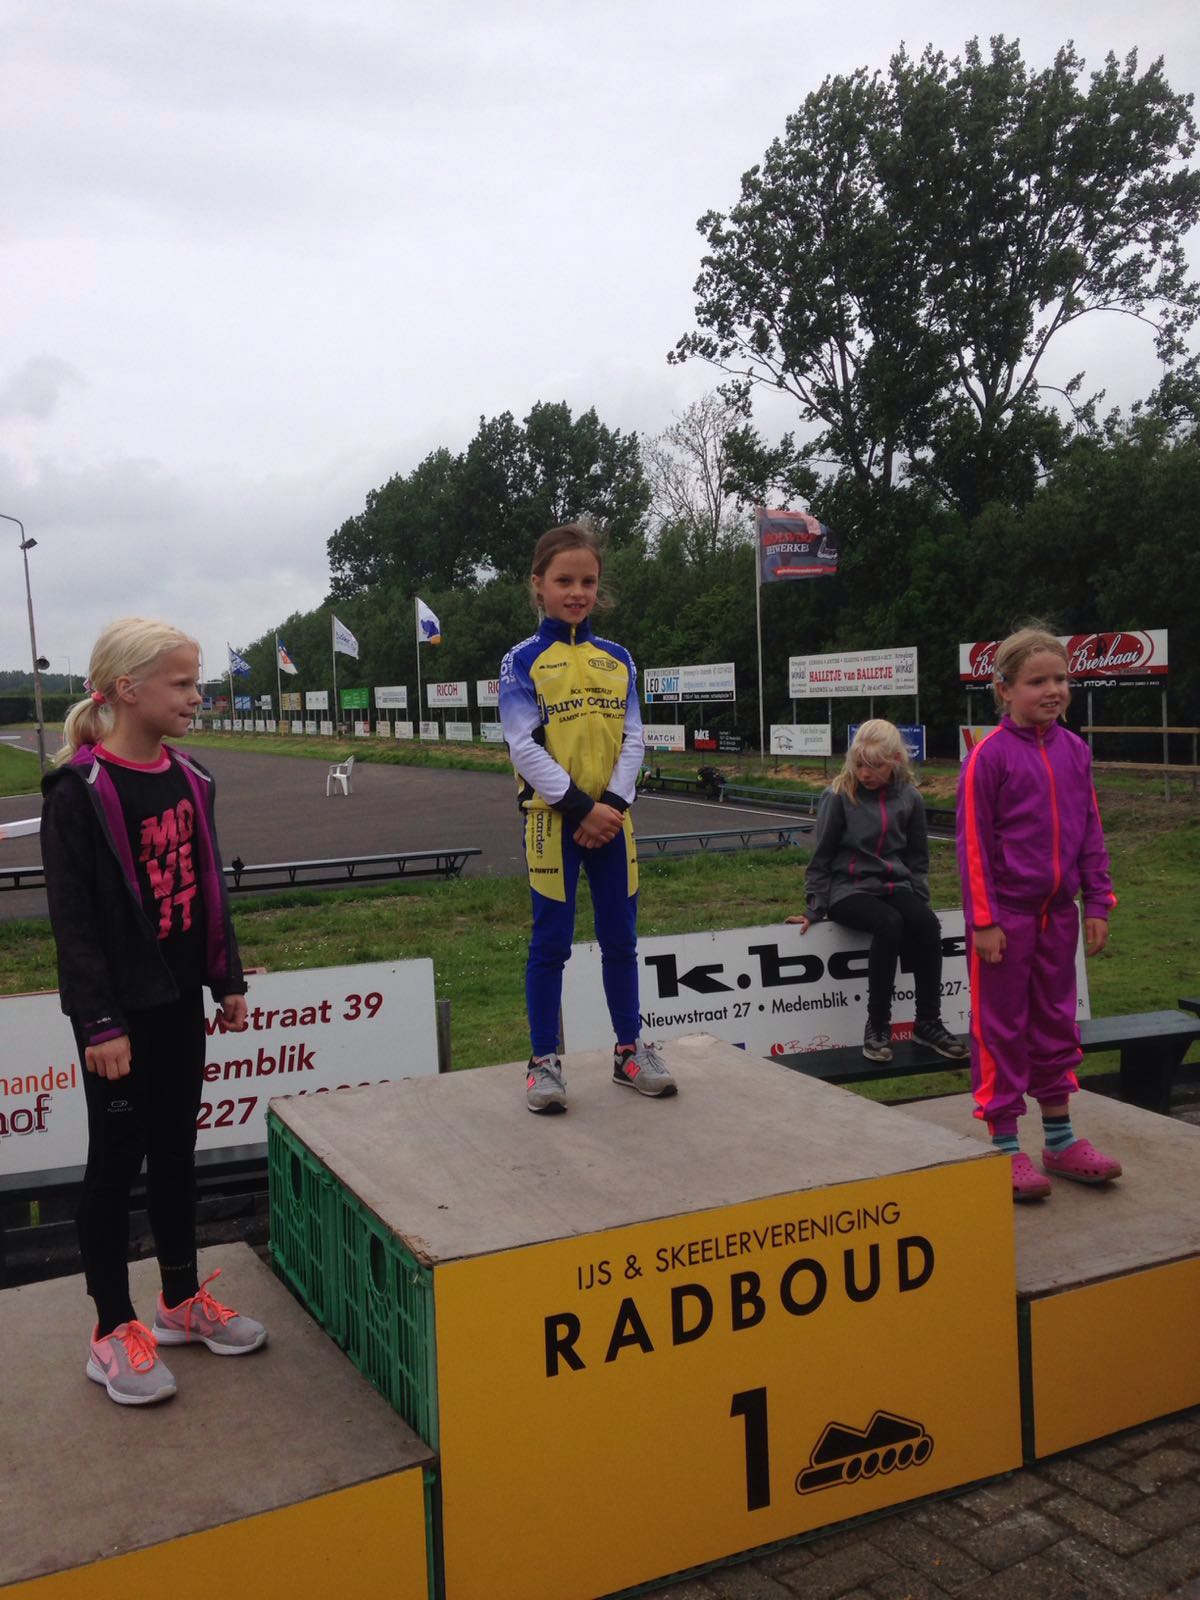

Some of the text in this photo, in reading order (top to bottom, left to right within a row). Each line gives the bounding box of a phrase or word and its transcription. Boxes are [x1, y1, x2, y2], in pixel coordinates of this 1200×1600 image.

[1068, 634, 1140, 673] Bierkaai
[436, 684, 458, 696] RICOH
[646, 678, 659, 693] LEO
[809, 666, 893, 682] HALLETJE van BALLETJE
[647, 734, 675, 742] MATCH
[536, 812, 545, 855] aarder
[343, 992, 384, 1021] 39
[640, 1008, 728, 1028] Nieuwstraat
[733, 1002, 751, 1018] 27
[772, 991, 849, 1014] Medemblik
[203, 1042, 316, 1083] emblik
[196, 1096, 258, 1130] 227
[577, 1200, 901, 1291] IJS & SKEELERVERENIGING
[543, 1233, 936, 1379] RADBOUD
[729, 1385, 771, 1513] 1
